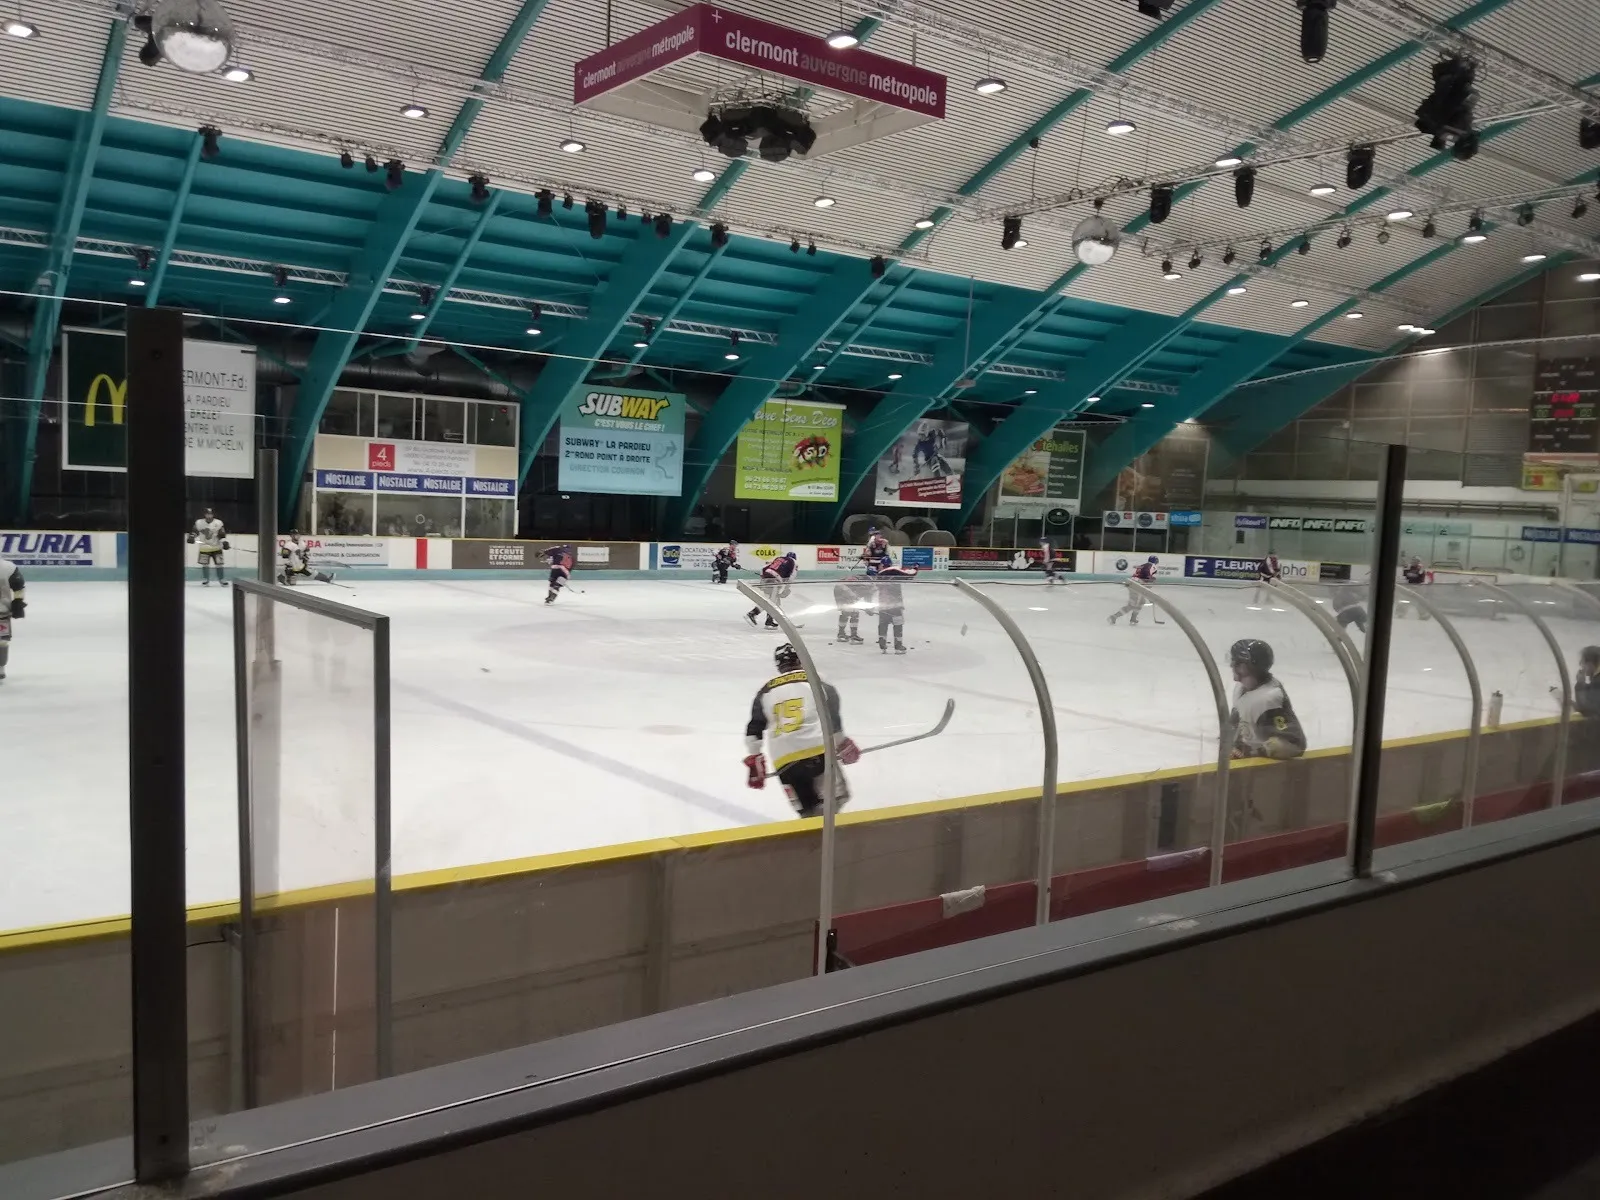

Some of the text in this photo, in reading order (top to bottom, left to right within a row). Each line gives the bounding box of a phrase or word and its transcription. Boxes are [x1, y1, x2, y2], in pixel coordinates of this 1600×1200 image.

[582, 25, 695, 89] clermont auvergne métropole
[725, 28, 938, 107] clermont auvergne métropole
[577, 391, 671, 421] SUBWAY
[635, 420, 645, 431] LE
[565, 437, 652, 451] SUBWAY LA PARDIEU
[376, 446, 387, 461] 4
[574, 451, 595, 460] ROND
[596, 452, 617, 461] POINT
[626, 454, 651, 463] DROITE
[325, 472, 367, 486] NOSTALGIE
[379, 475, 419, 489] NOSTALGIE
[424, 477, 461, 491] NOSTALGIE
[473, 479, 509, 493] NOSTALGIE
[1270, 518, 1300, 528] INFO
[1303, 519, 1333, 529] INFO
[1335, 521, 1366, 530] INFO
[755, 548, 776, 557] COLAS
[1215, 560, 1260, 571] FLEURY
[773, 697, 804, 737] 15
